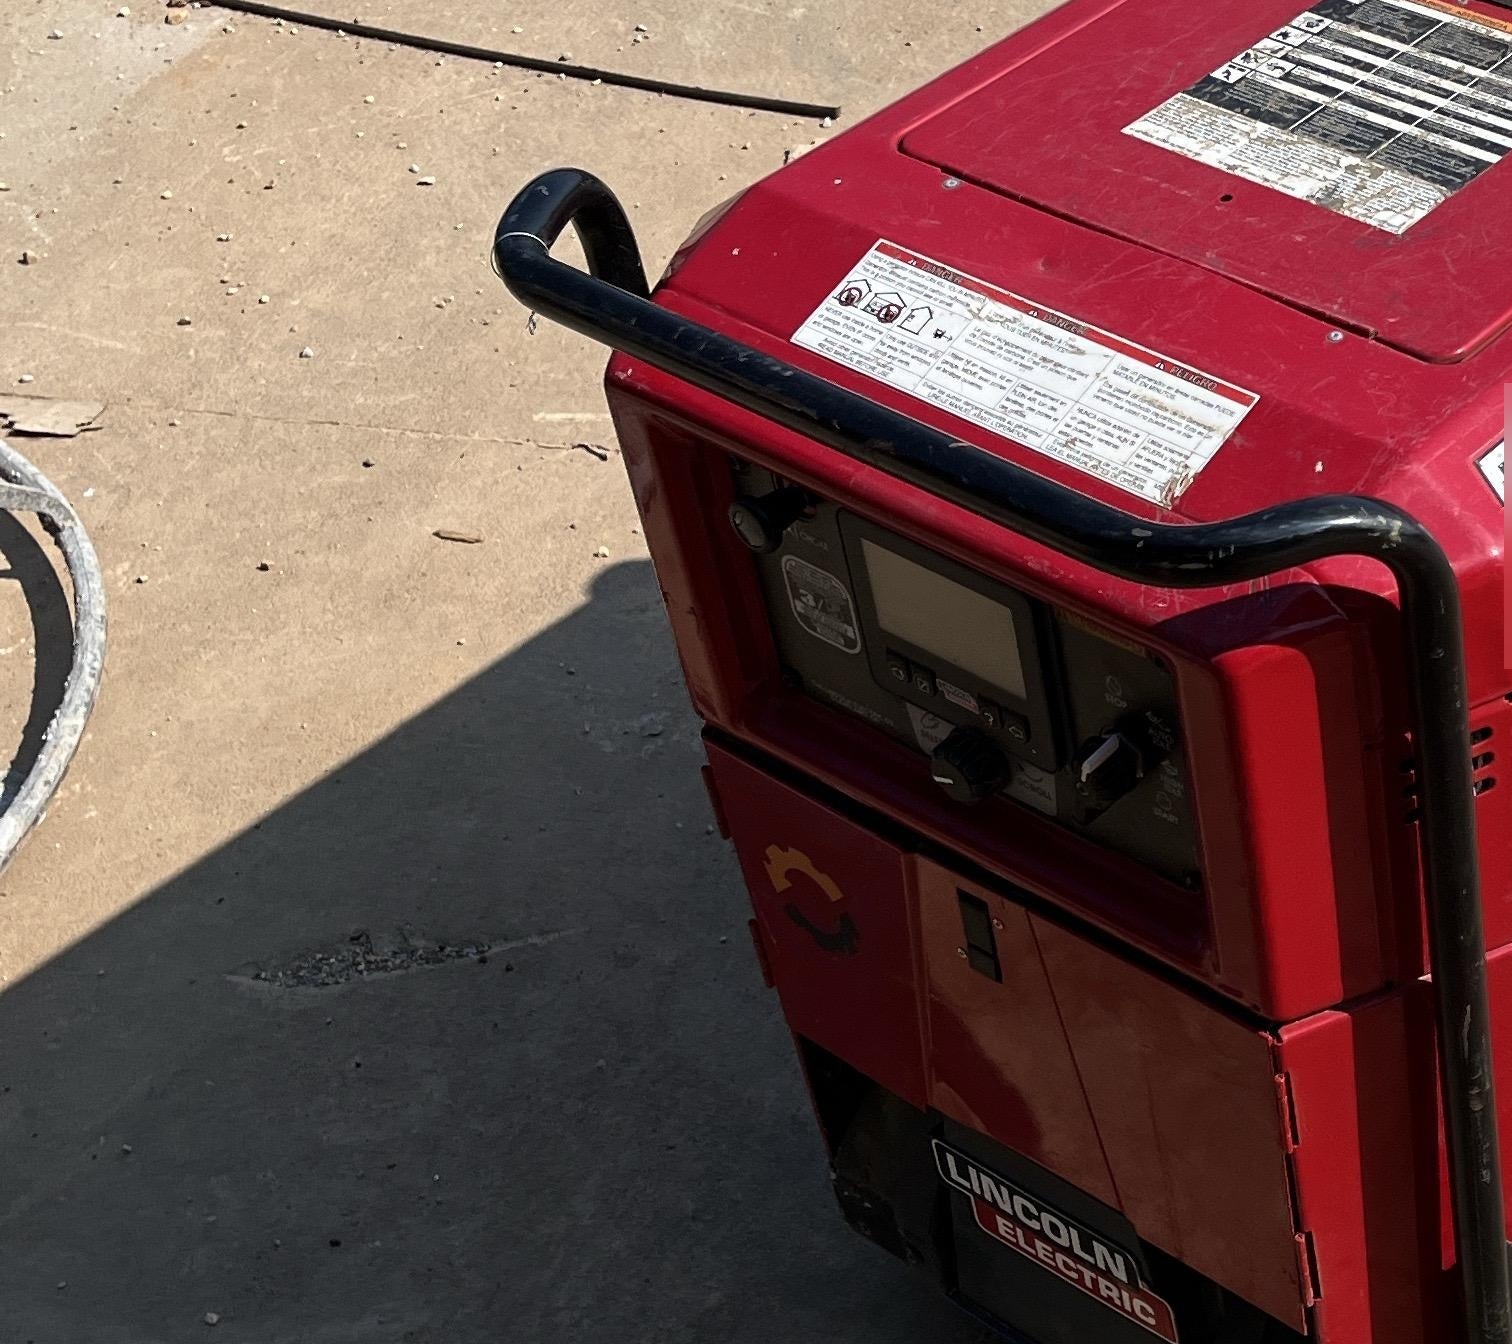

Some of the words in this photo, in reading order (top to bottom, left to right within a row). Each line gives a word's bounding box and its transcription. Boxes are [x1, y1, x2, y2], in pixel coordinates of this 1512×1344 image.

[1168, 366, 1218, 390] PELIGRO
[945, 1152, 1128, 1284] LINCOLN
[995, 1214, 1156, 1326] ELECTRIC
